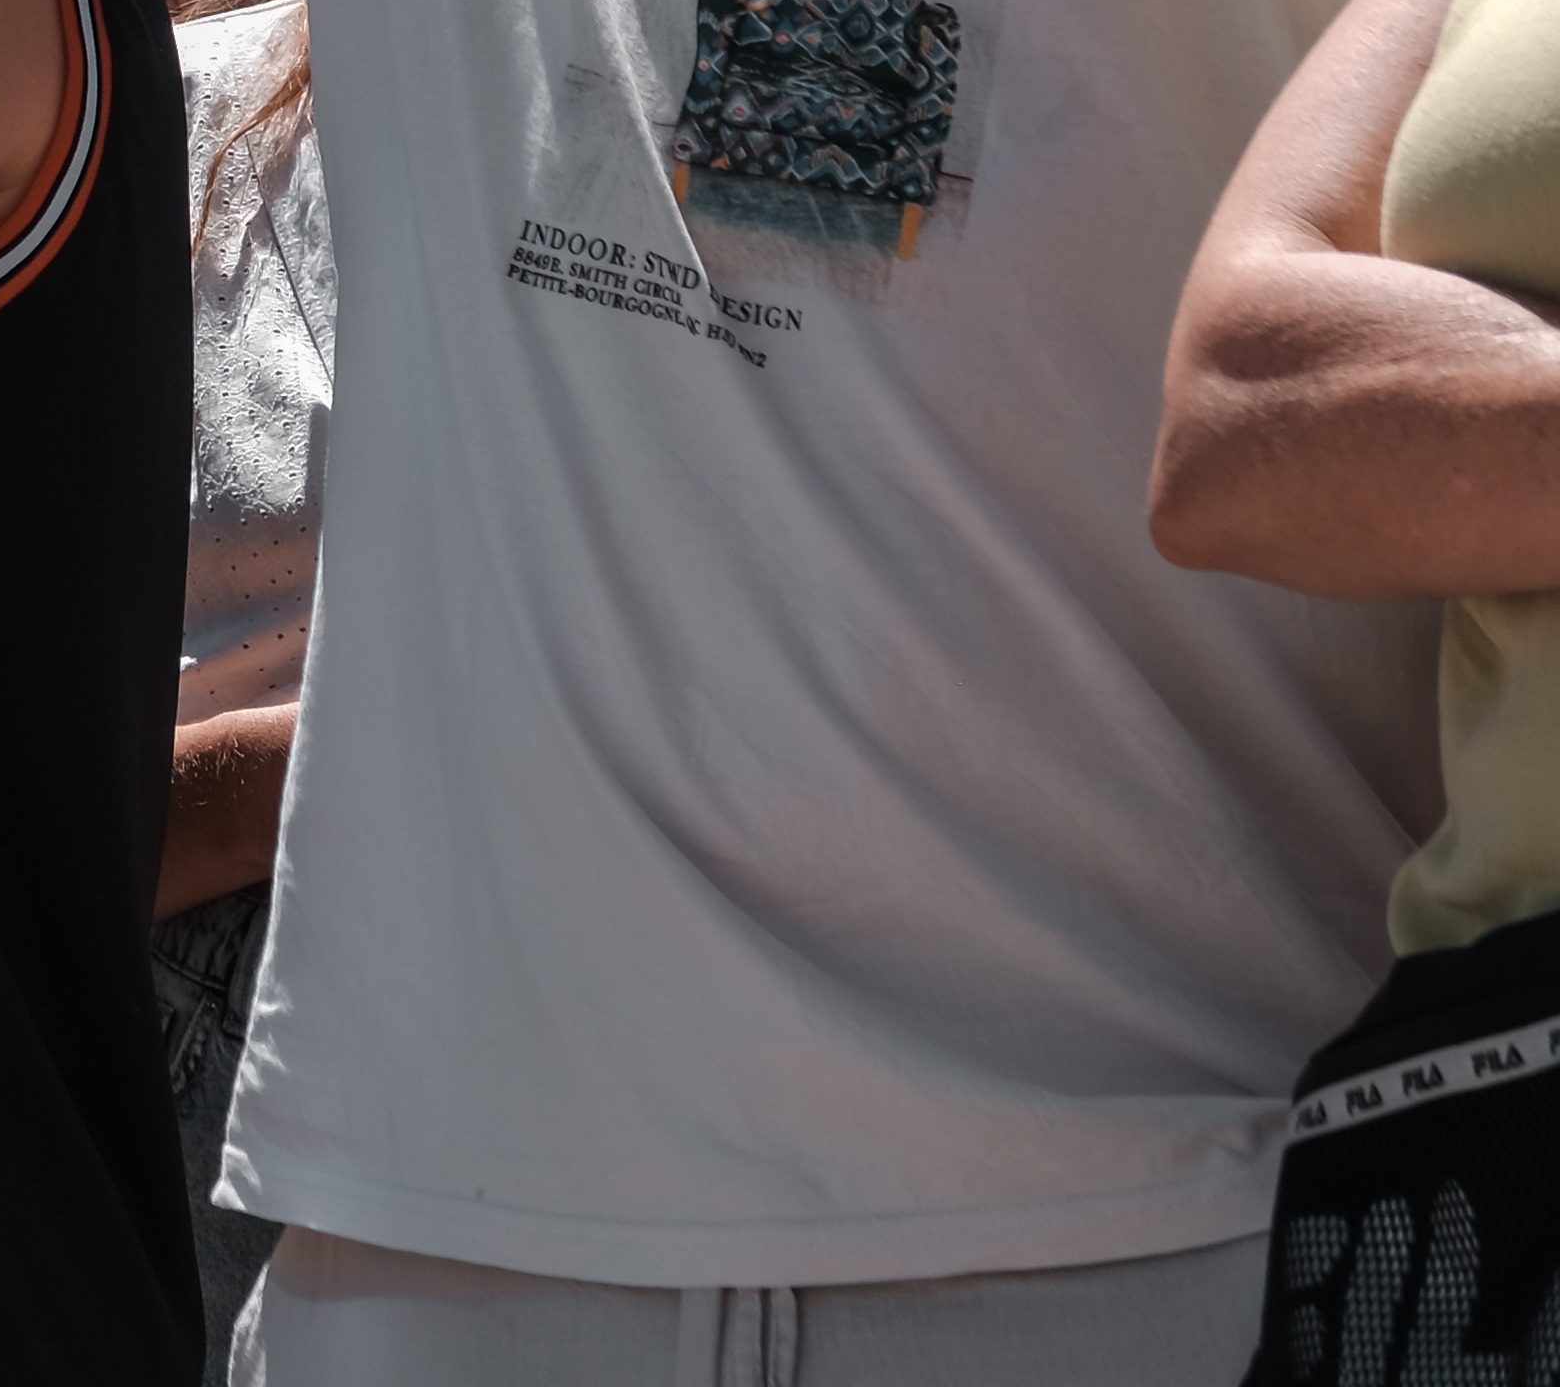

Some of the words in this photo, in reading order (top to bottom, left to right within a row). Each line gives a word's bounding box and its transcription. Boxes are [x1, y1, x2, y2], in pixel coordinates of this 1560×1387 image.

[519, 219, 637, 269] INDOOR:
[569, 262, 628, 291] SMITH
[1344, 1081, 1383, 1117] FILA
[1401, 1060, 1445, 1096] FILA
[1470, 1042, 1526, 1080] FILA
